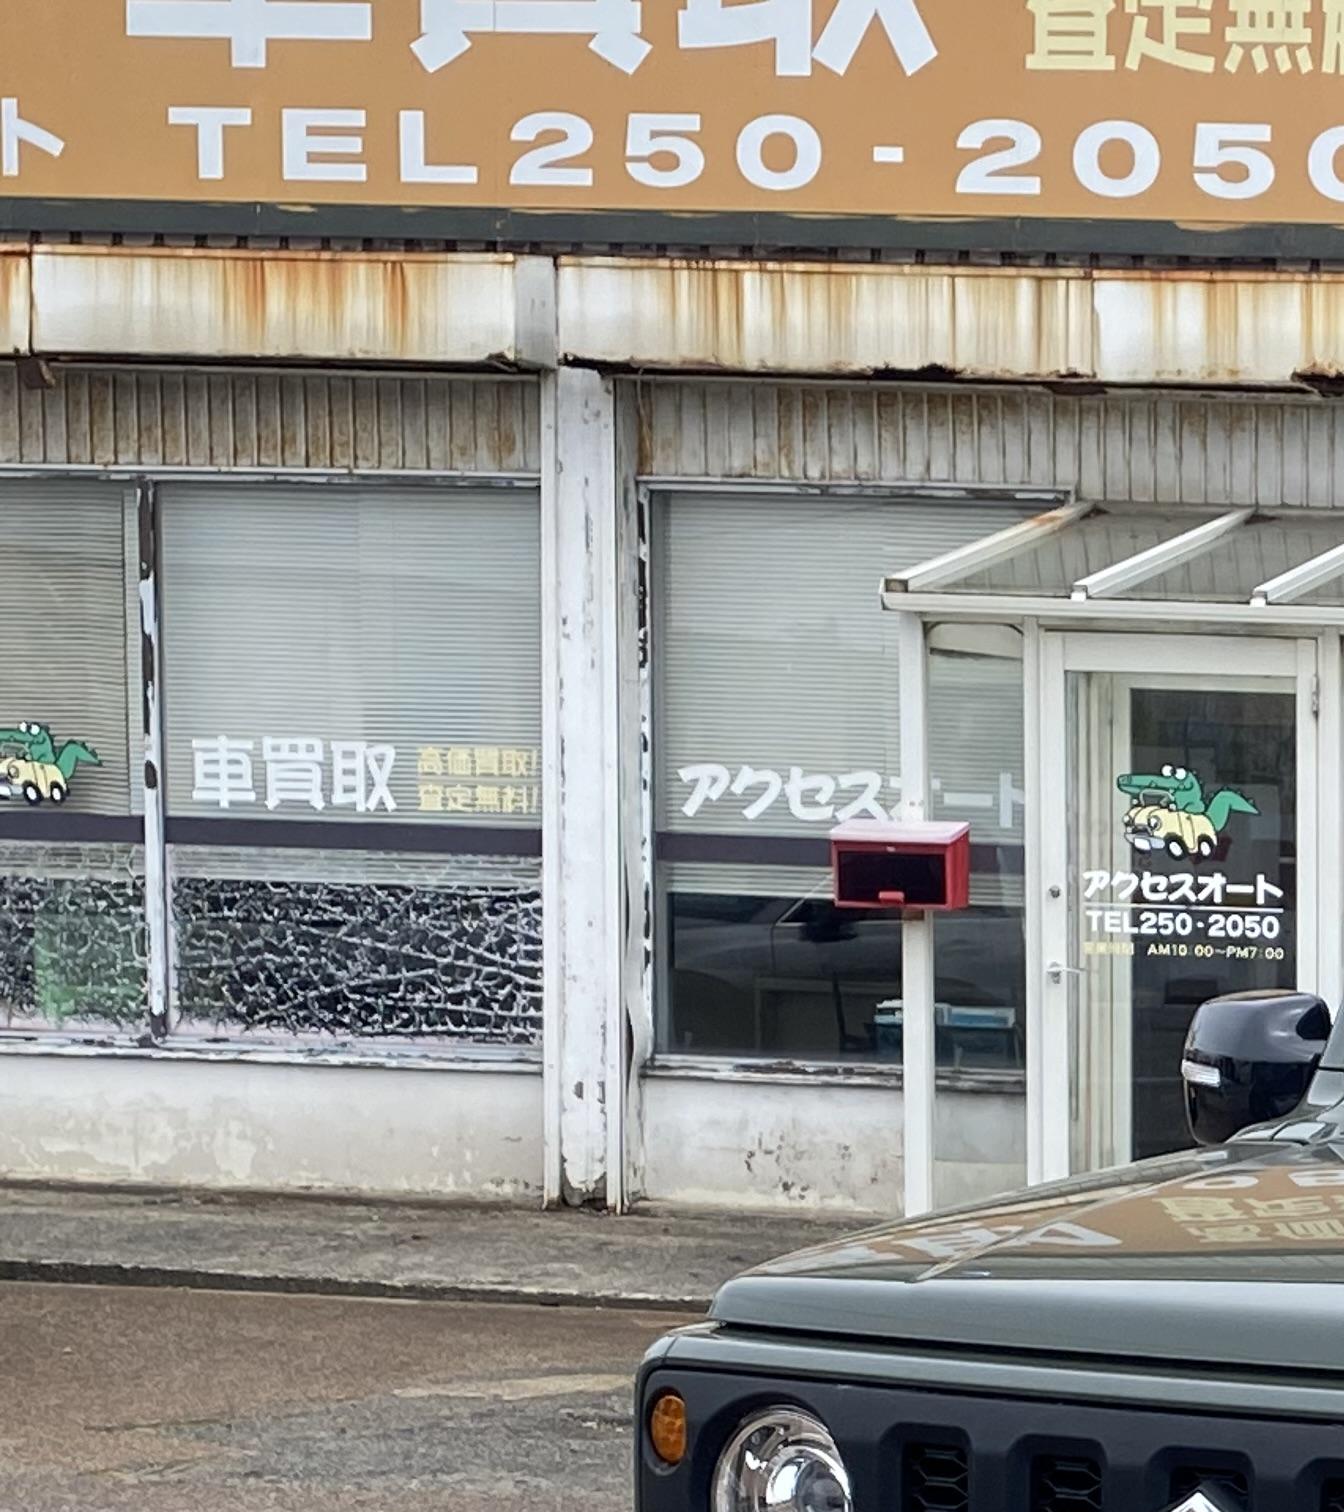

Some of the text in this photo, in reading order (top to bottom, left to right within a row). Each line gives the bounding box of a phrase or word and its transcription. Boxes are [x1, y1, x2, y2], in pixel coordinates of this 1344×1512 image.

[191, 735, 398, 812] 車買取
[677, 763, 1025, 829] アクセスート
[1082, 869, 1285, 905] アクセスオート
